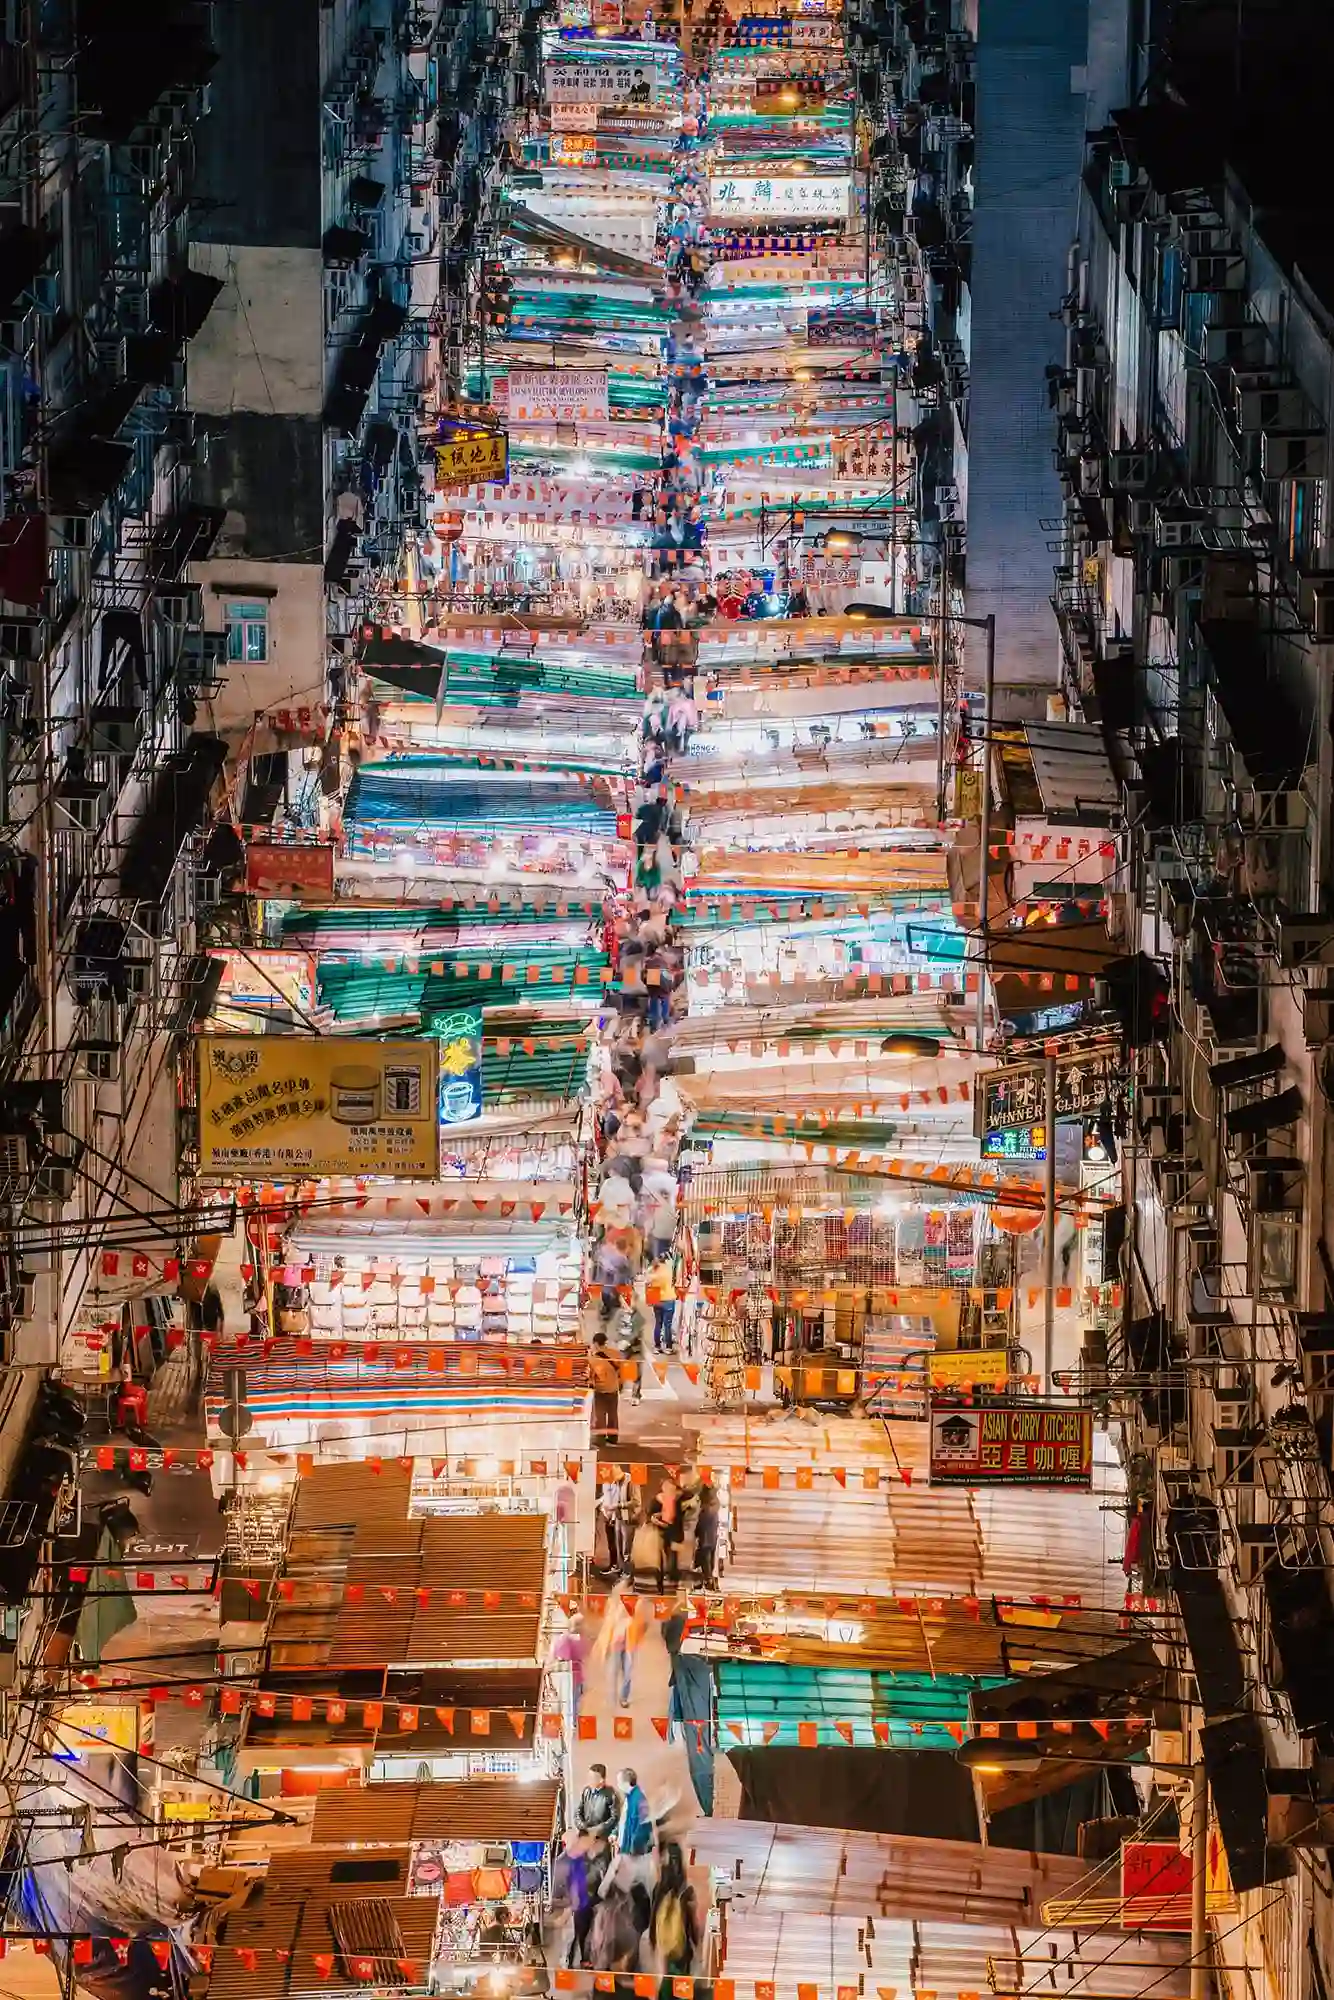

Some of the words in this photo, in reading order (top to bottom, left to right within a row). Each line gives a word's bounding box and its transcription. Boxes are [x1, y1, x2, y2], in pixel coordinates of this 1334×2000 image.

[1056, 1094, 1091, 1113] CLUB
[981, 1412, 1008, 1441] ASIAN
[1011, 1412, 1042, 1441] CURRY
[1043, 1413, 1081, 1442] KITCHEN
[980, 1444, 1081, 1471] 亞星咖喱
